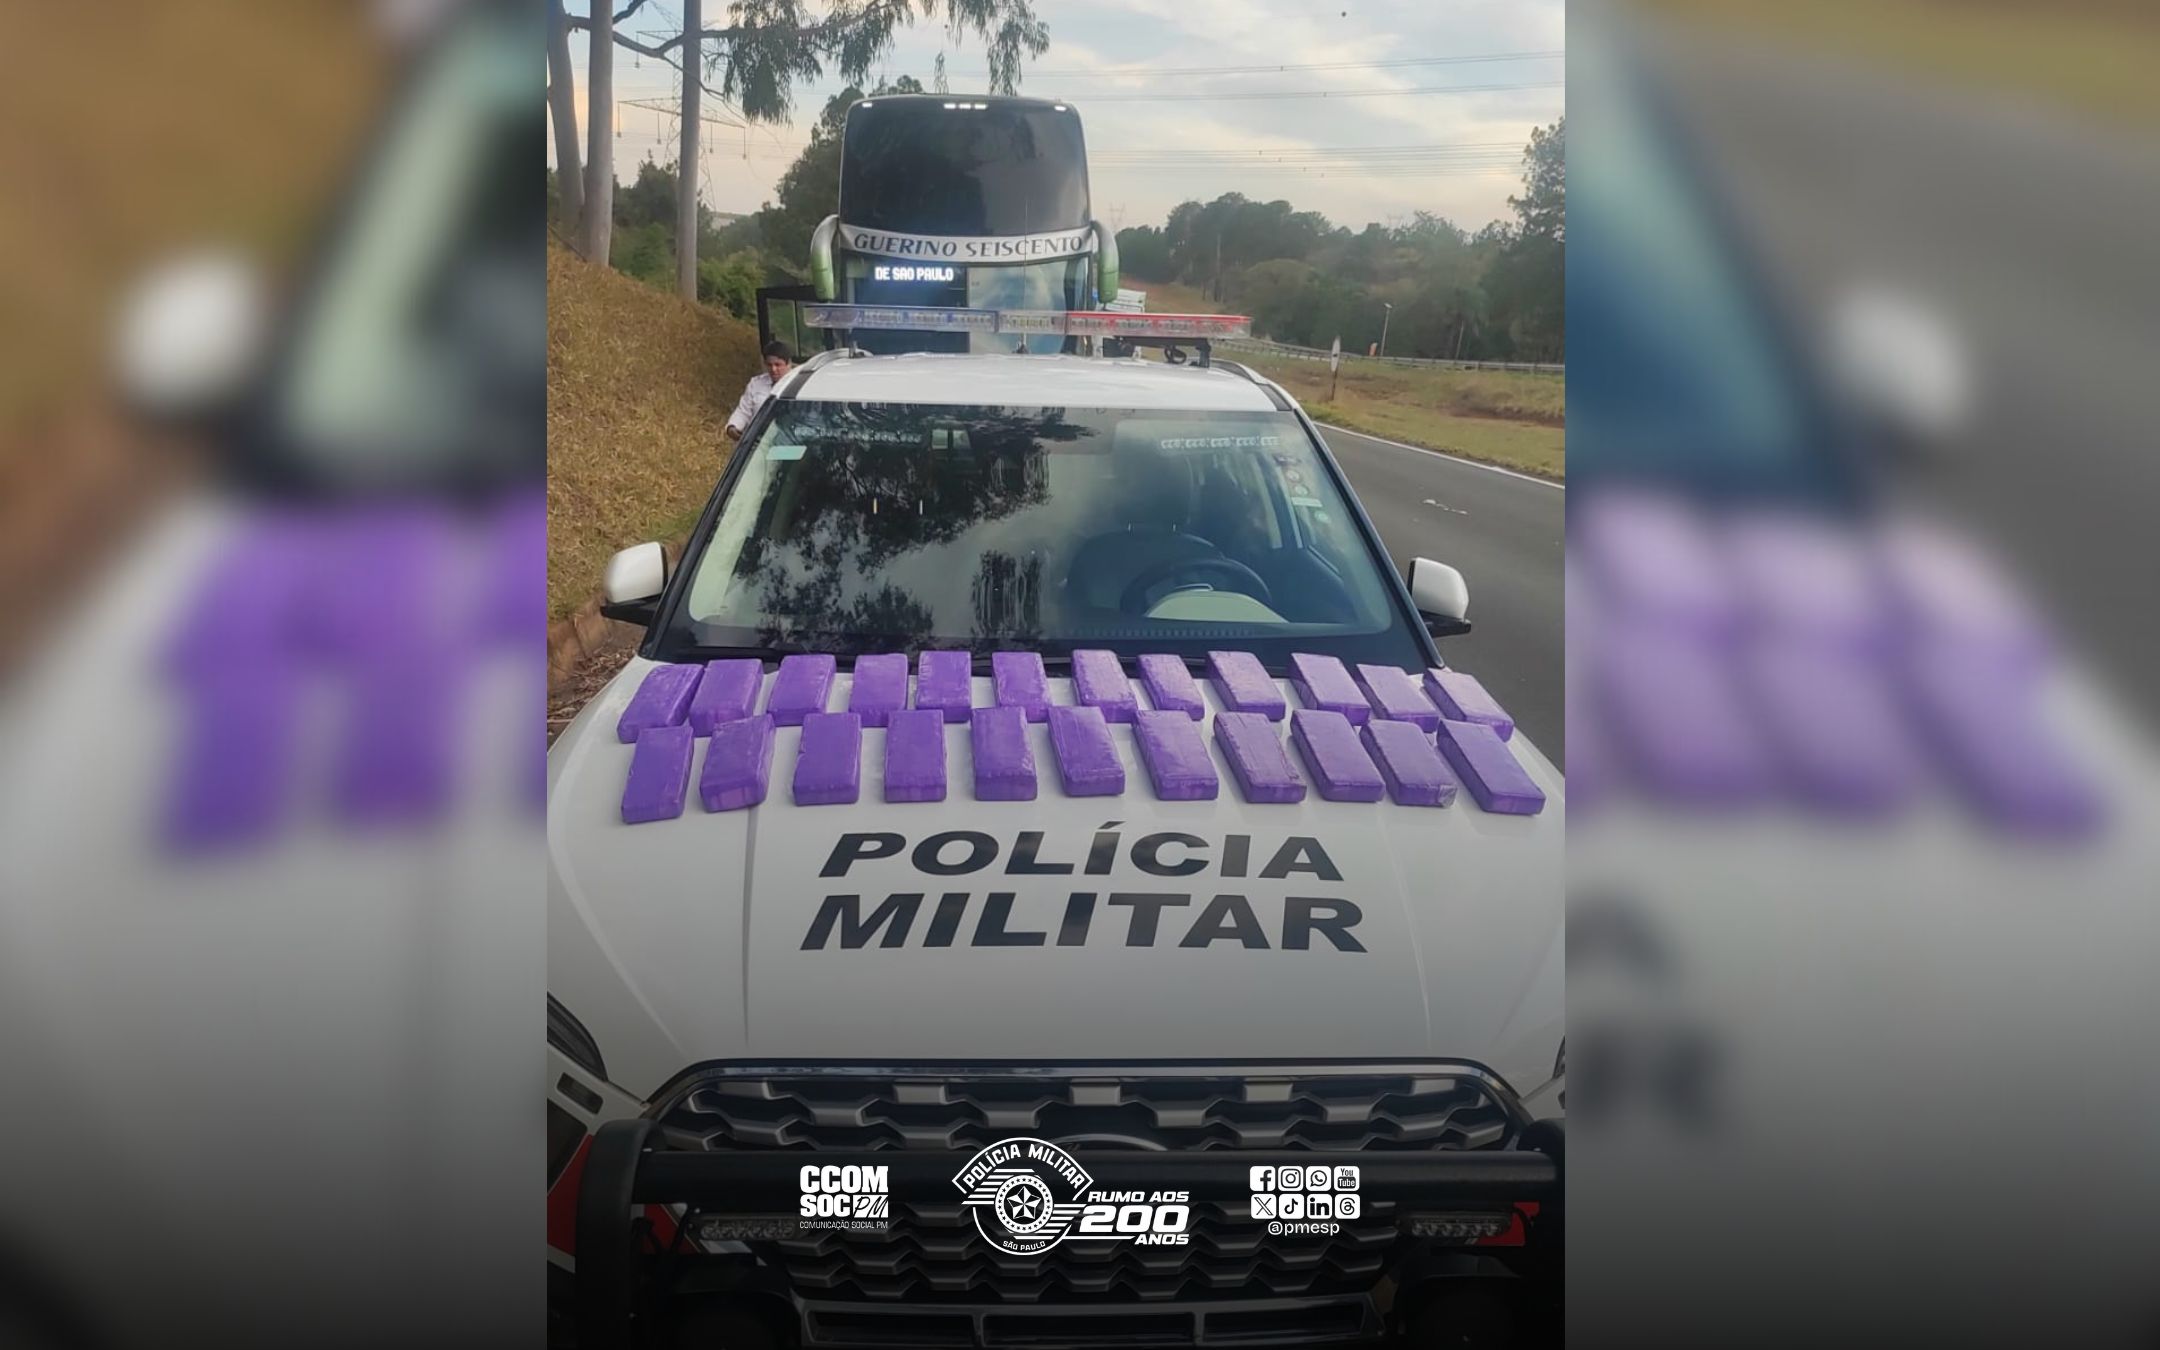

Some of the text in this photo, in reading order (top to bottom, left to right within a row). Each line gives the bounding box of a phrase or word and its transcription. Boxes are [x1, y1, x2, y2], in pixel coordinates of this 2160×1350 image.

[854, 233, 1083, 257] GUERINO SEISCENTO
[875, 267, 954, 282] DE SAO PAULO
[818, 821, 1345, 882] POLÍCIA
[800, 892, 1368, 953] MILITAR
